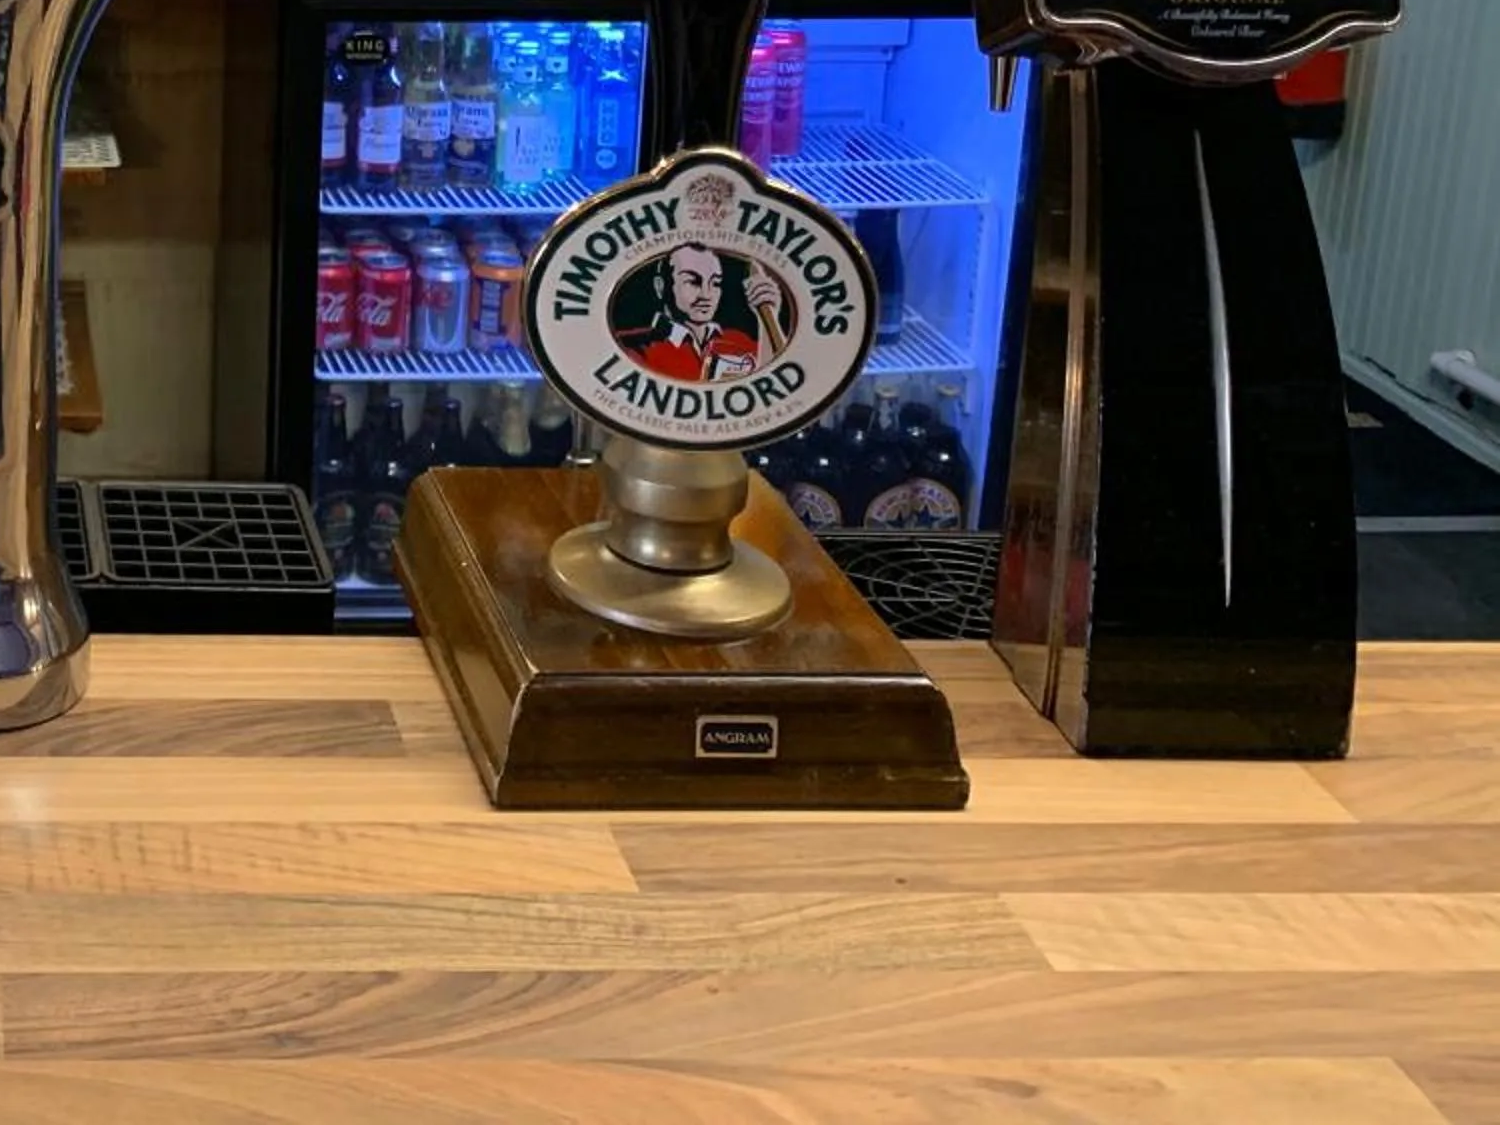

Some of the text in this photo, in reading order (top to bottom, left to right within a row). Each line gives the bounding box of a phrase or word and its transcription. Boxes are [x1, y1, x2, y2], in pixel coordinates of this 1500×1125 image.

[554, 197, 856, 337] TIMOTHY TAYLOR'S
[623, 230, 743, 261] CHAMPIONSHIP
[593, 353, 806, 421] LANDLORD
[704, 732, 772, 746] ANGRAM
